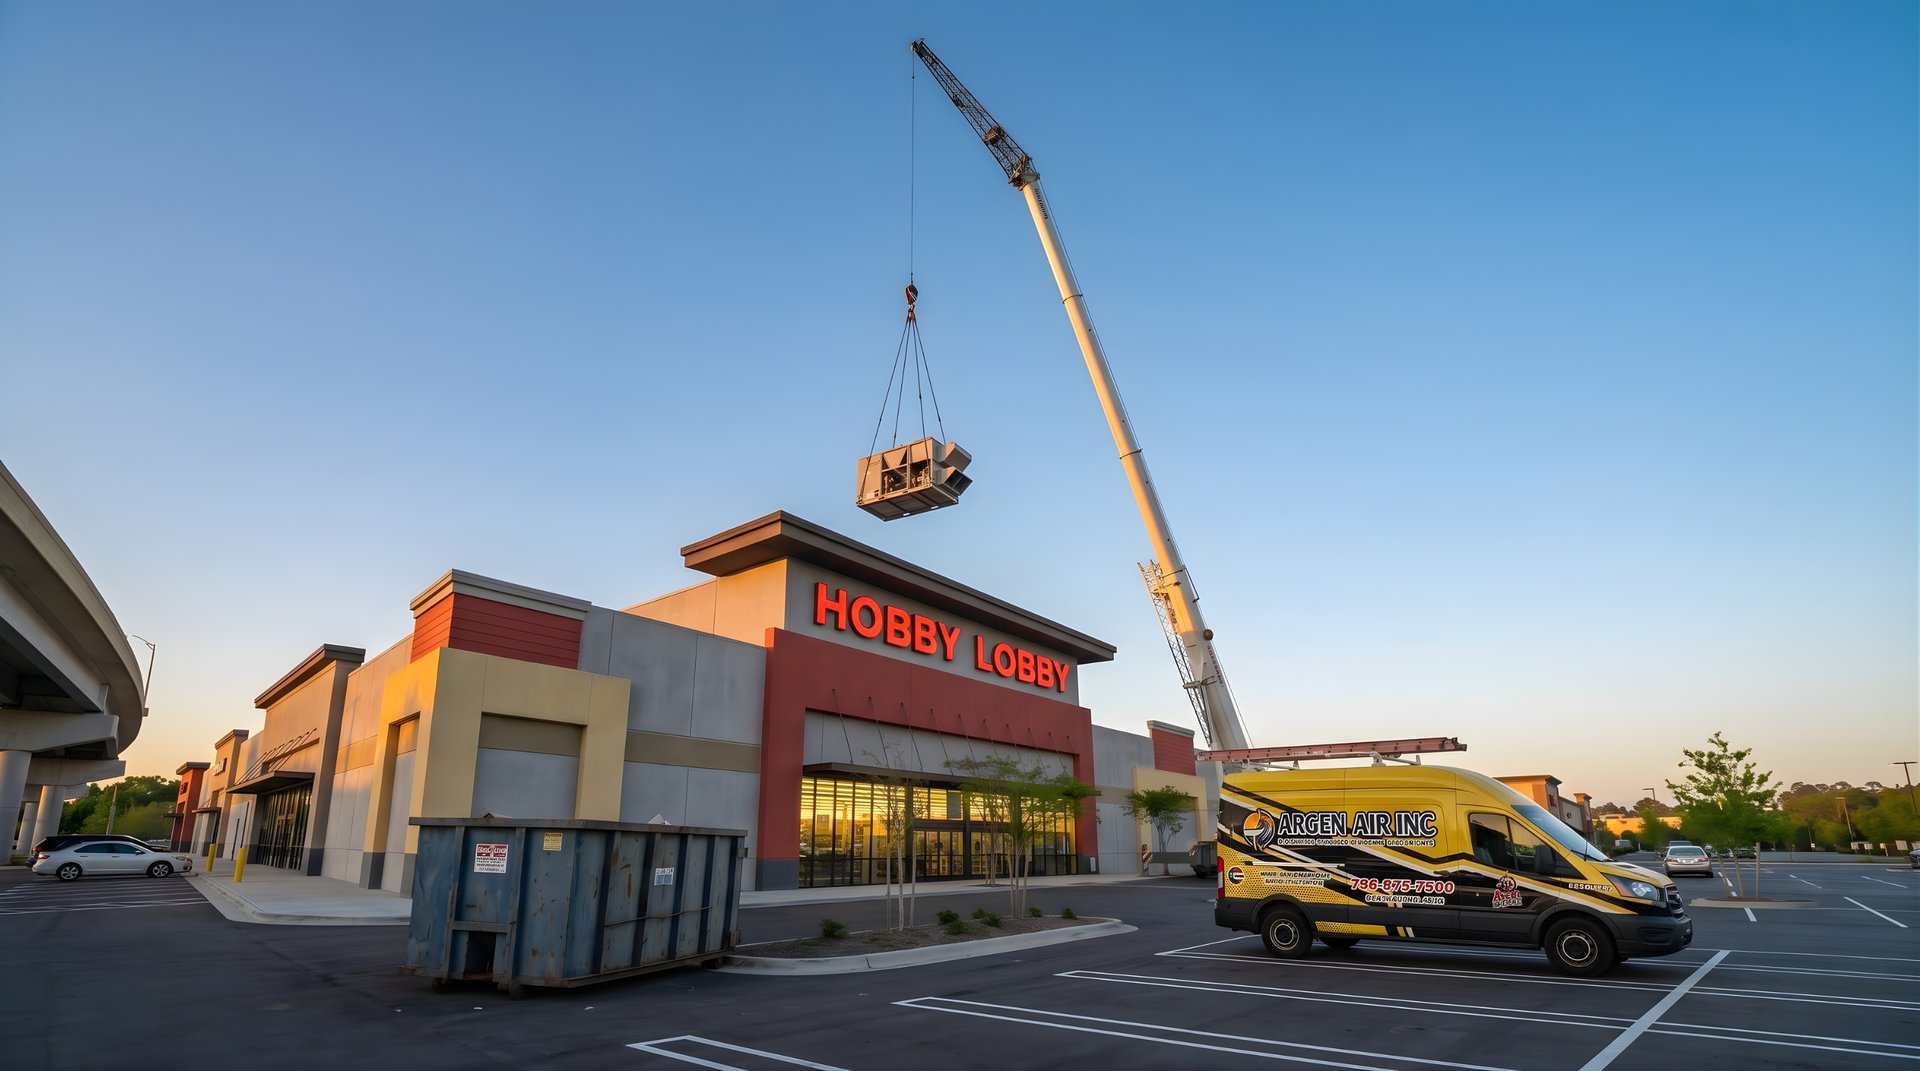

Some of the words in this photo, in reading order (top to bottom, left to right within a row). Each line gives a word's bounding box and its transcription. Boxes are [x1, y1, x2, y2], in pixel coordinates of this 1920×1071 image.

[815, 582, 960, 661] HOBBY
[974, 635, 1070, 692] LOBBY
[1278, 813, 1347, 836] ARGEN
[1353, 813, 1392, 836] AIR
[1396, 813, 1437, 837] INC
